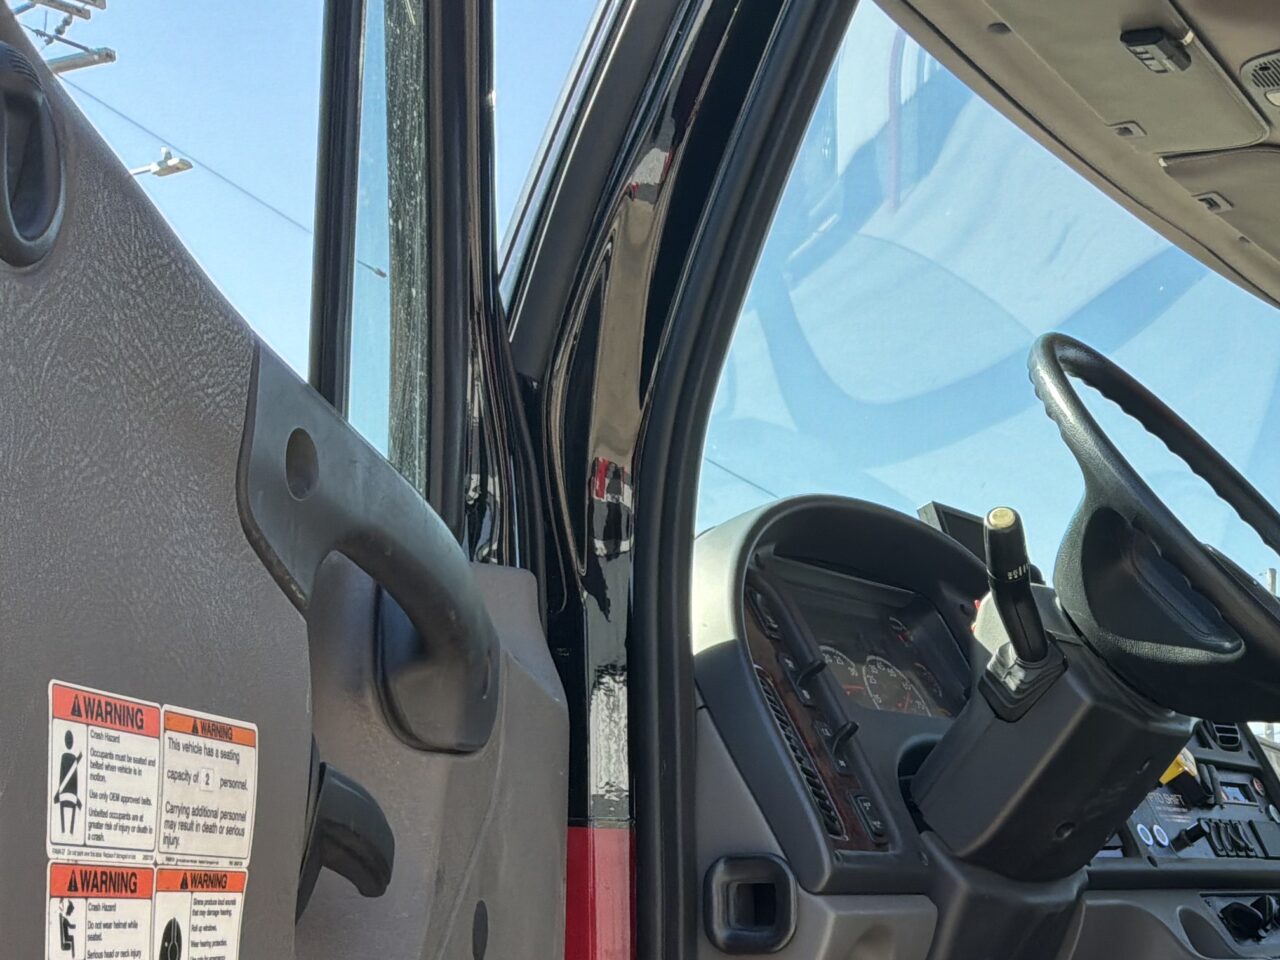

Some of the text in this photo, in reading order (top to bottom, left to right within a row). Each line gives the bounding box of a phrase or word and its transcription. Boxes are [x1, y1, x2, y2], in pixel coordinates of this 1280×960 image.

[83, 696, 144, 730] WARNING
[200, 720, 232, 741] WARNING
[182, 741, 202, 755] vehicle
[220, 750, 240, 765] seating
[167, 770, 192, 786] capacity
[165, 801, 247, 823] Carrying additional personnel
[178, 820, 194, 832] result
[202, 821, 218, 834] death
[225, 826, 245, 837] serious
[80, 870, 137, 894] WARNING
[190, 872, 228, 889] WARNING
